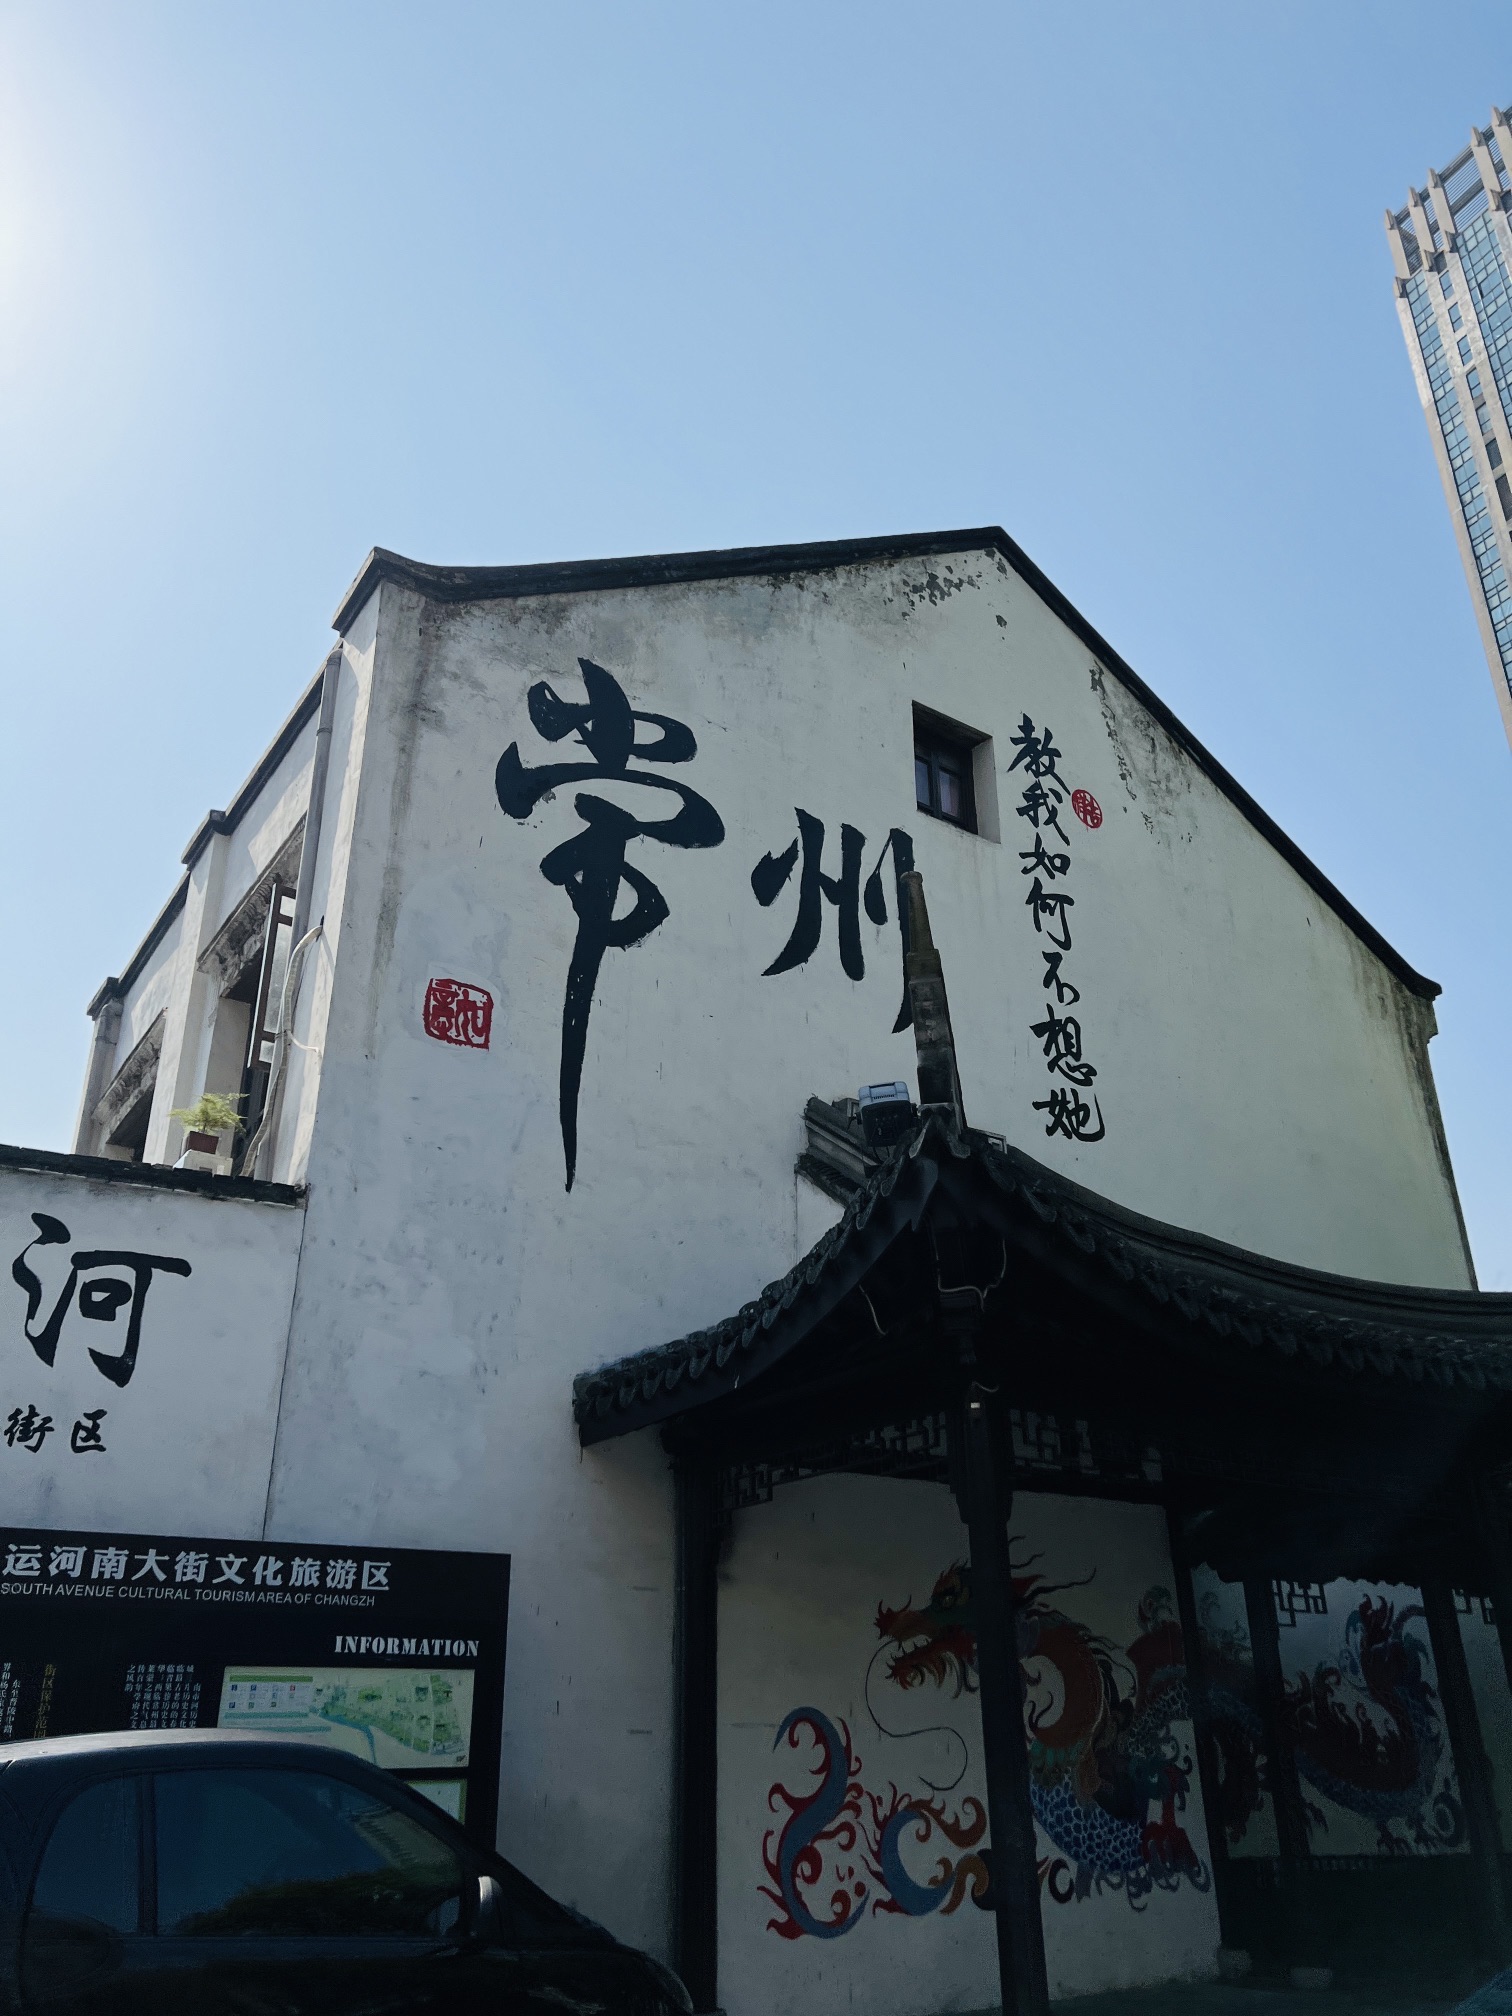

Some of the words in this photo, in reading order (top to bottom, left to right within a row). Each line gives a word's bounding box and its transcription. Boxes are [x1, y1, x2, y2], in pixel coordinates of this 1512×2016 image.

[494, 658, 914, 1193] 常州
[1008, 713, 1107, 1142] 教我如何不想她
[12, 1212, 193, 1388] 河
[4, 1404, 108, 1454] 街区
[2, 1543, 392, 1592] 运河南大街文化旅游区
[0, 1582, 53, 1596] SOUTH
[55, 1584, 115, 1598] AVENUE
[118, 1586, 191, 1600] CULTURAL
[194, 1588, 255, 1603] TOURISM
[257, 1591, 292, 1604] AREA
[294, 1593, 312, 1605] OF
[315, 1594, 376, 1608] CHANGZH
[334, 1635, 480, 1658] INFORMATION
